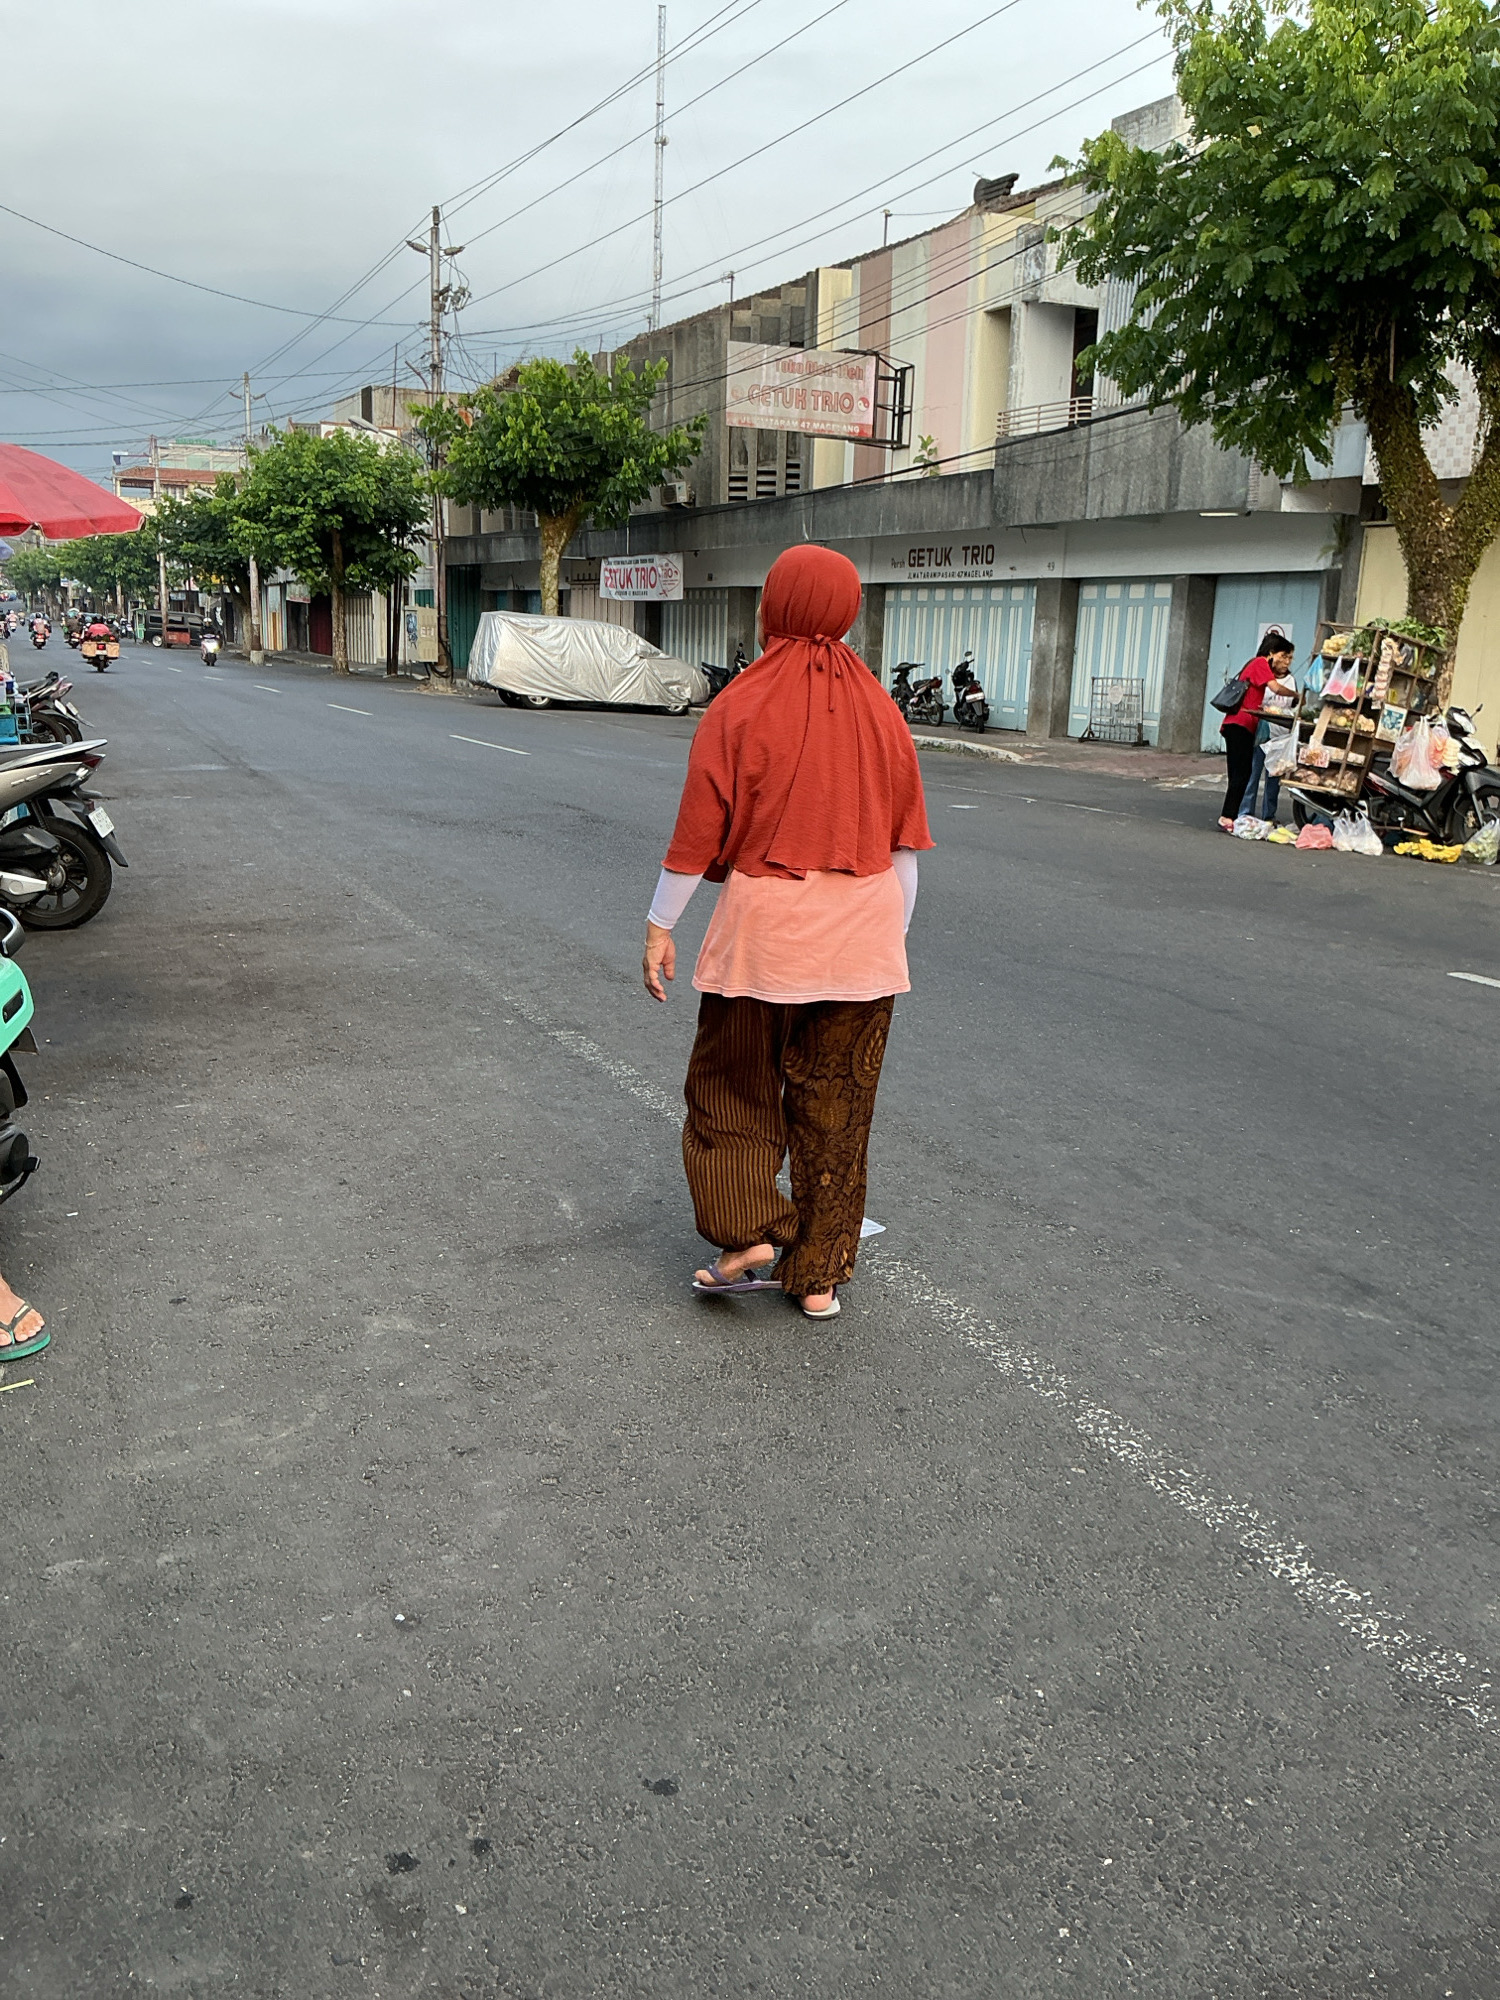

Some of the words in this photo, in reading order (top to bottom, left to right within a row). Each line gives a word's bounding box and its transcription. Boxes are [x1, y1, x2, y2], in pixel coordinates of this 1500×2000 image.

[748, 384, 807, 411] GETUK
[811, 390, 855, 415] TRIO
[908, 547, 952, 568] GETUK
[961, 544, 995, 566] TRIO
[635, 565, 658, 590] TRIO
